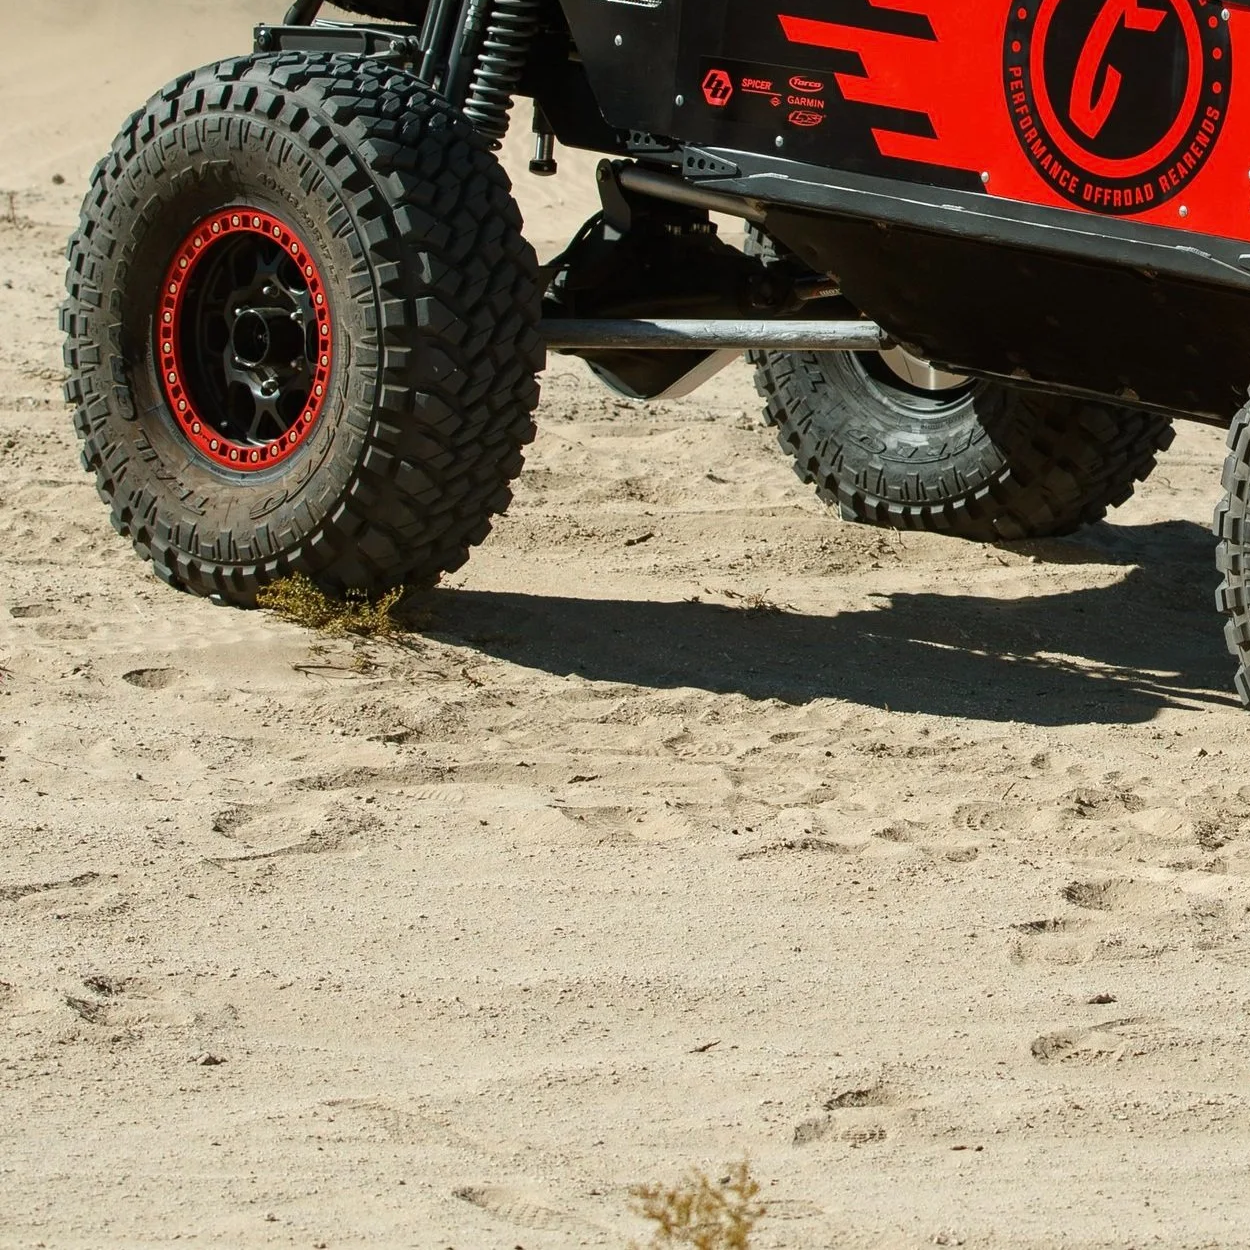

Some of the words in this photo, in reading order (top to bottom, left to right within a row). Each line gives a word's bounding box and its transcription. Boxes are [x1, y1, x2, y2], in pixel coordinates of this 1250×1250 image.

[741, 77, 772, 90] SPICER
[787, 95, 825, 109] GARMIN
[1008, 65, 1080, 194] PERFORMANCE
[1083, 182, 1154, 206] OFFROAD
[1158, 105, 1220, 193] REARENDS
